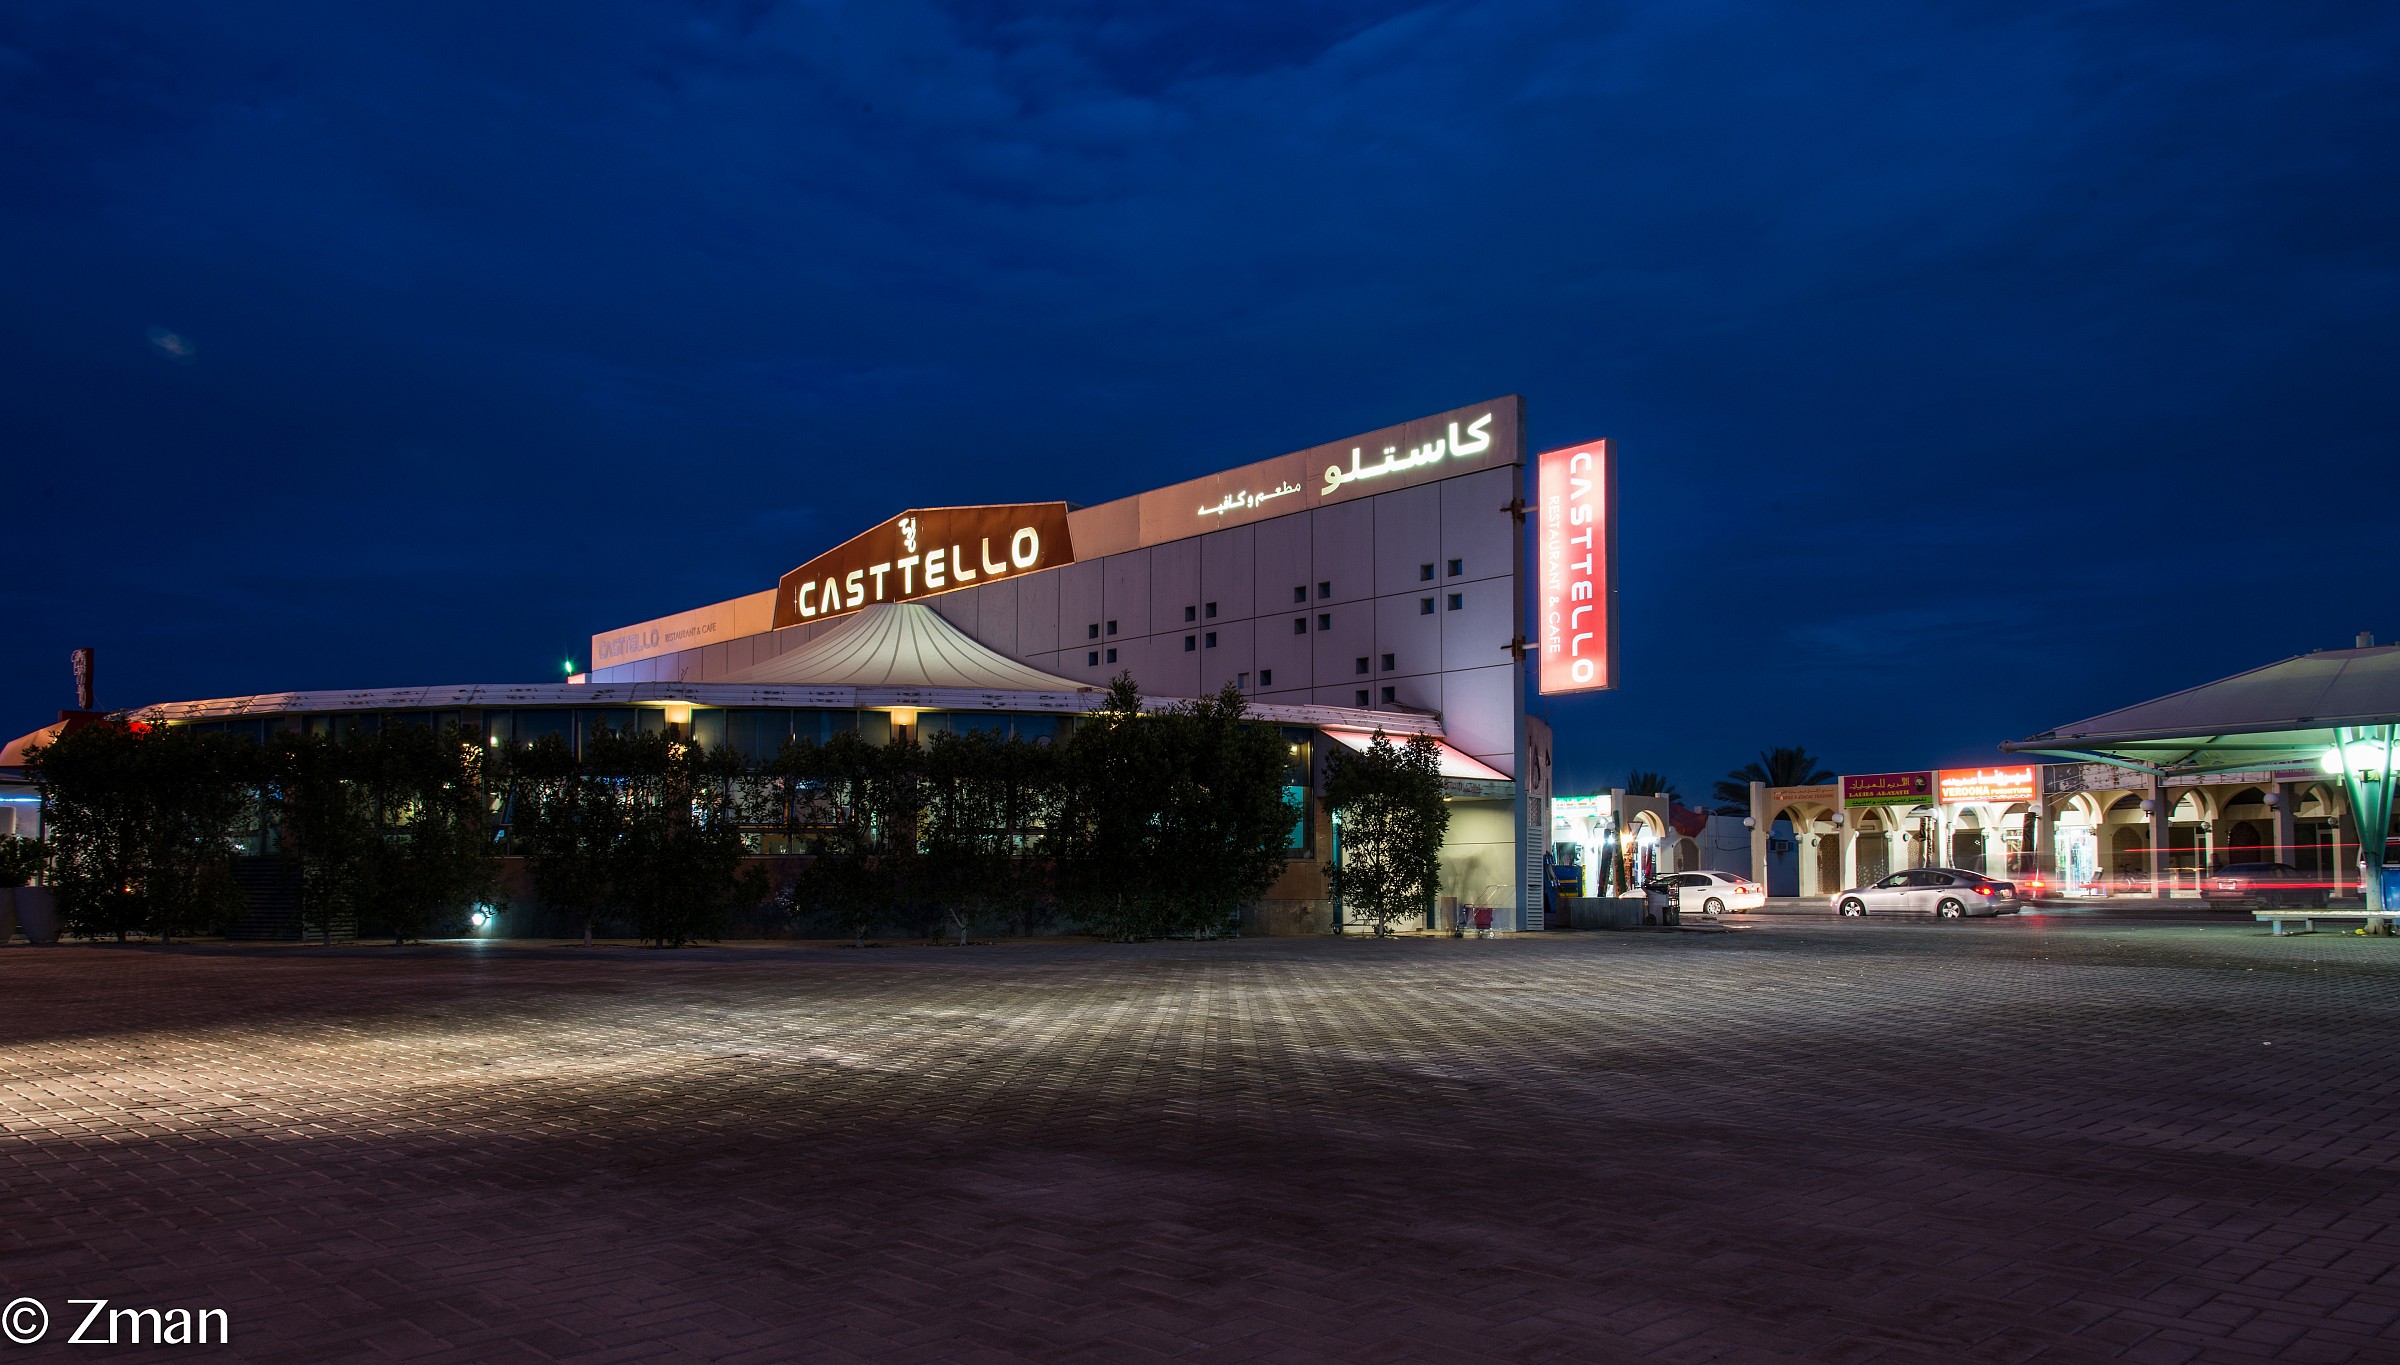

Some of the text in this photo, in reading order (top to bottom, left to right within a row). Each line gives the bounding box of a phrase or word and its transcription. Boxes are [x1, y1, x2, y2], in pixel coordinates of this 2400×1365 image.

[1255, 480, 1301, 507] مطعم
[1322, 413, 1492, 496] كاستلو
[799, 526, 1040, 616] CASTTELLO
[1548, 495, 1560, 653] RESTAURANT & CAFE
[1570, 452, 1594, 683] CASTTELLO
[598, 628, 660, 660] CASTTELLO
[664, 626, 697, 643] RESTAURANT
[701, 622, 717, 634] CAFE
[1942, 785, 2033, 797] VEROONA FURNITURE
